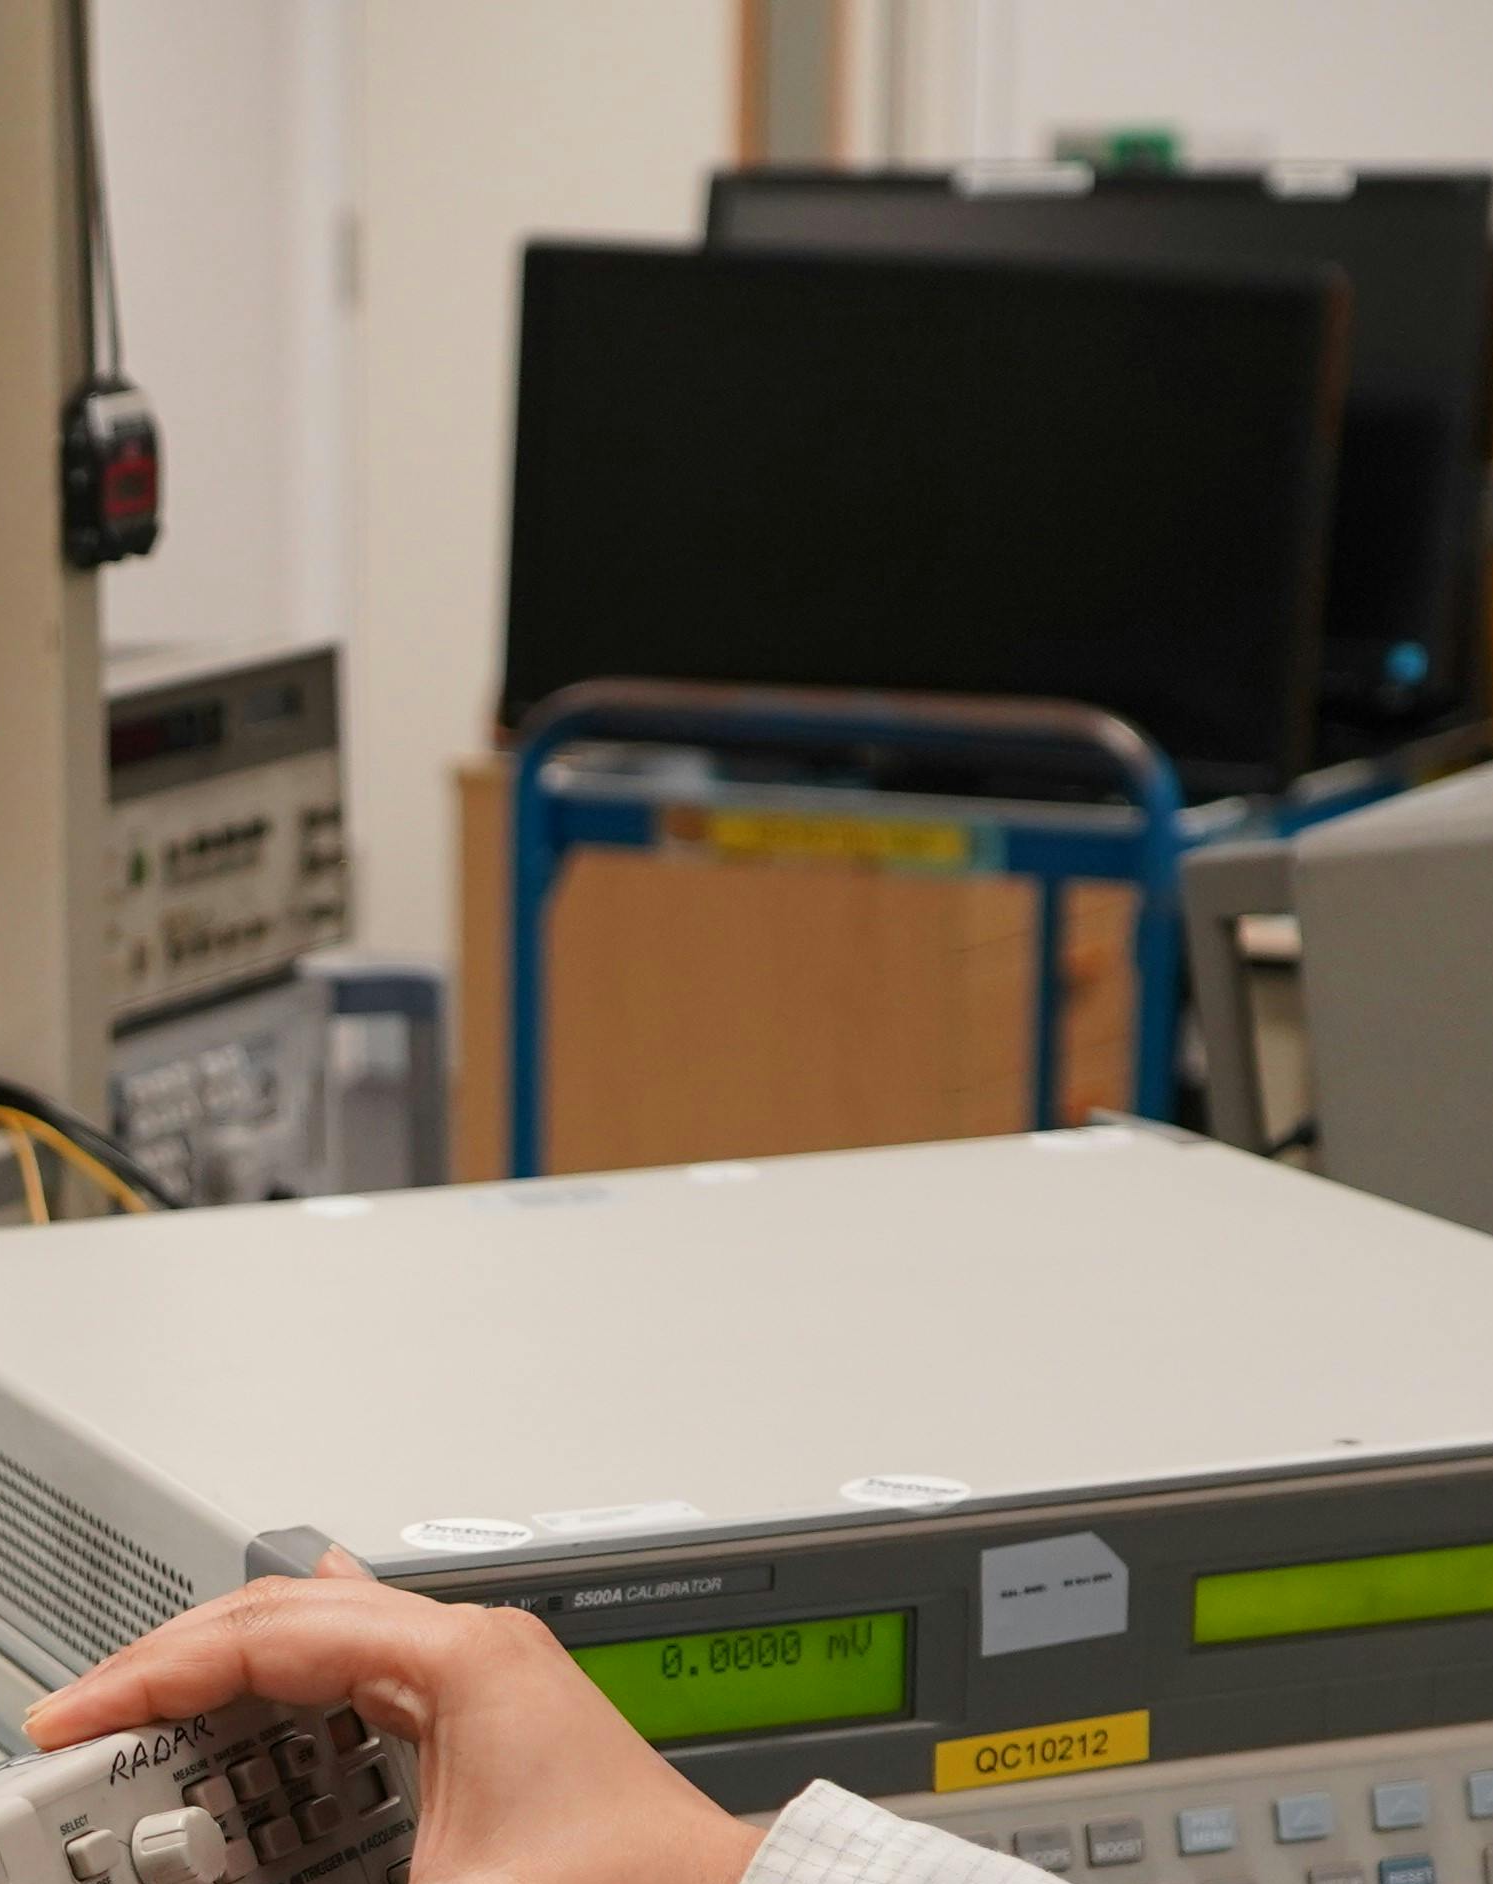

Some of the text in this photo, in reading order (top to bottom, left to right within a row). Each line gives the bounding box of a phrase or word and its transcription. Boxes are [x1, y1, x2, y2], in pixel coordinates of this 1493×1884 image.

[573, 1575, 723, 1609] 5500A CALIBRATOR
[660, 1621, 875, 1681] 0.0000 mV
[109, 1713, 215, 1786] RADAR
[974, 1730, 1109, 1776] QC10212
[172, 1755, 210, 1783] MEASURE
[59, 1812, 89, 1835] SELECT
[366, 1823, 408, 1853] ACQUIRE
[301, 1852, 346, 1884] TRIGGER
